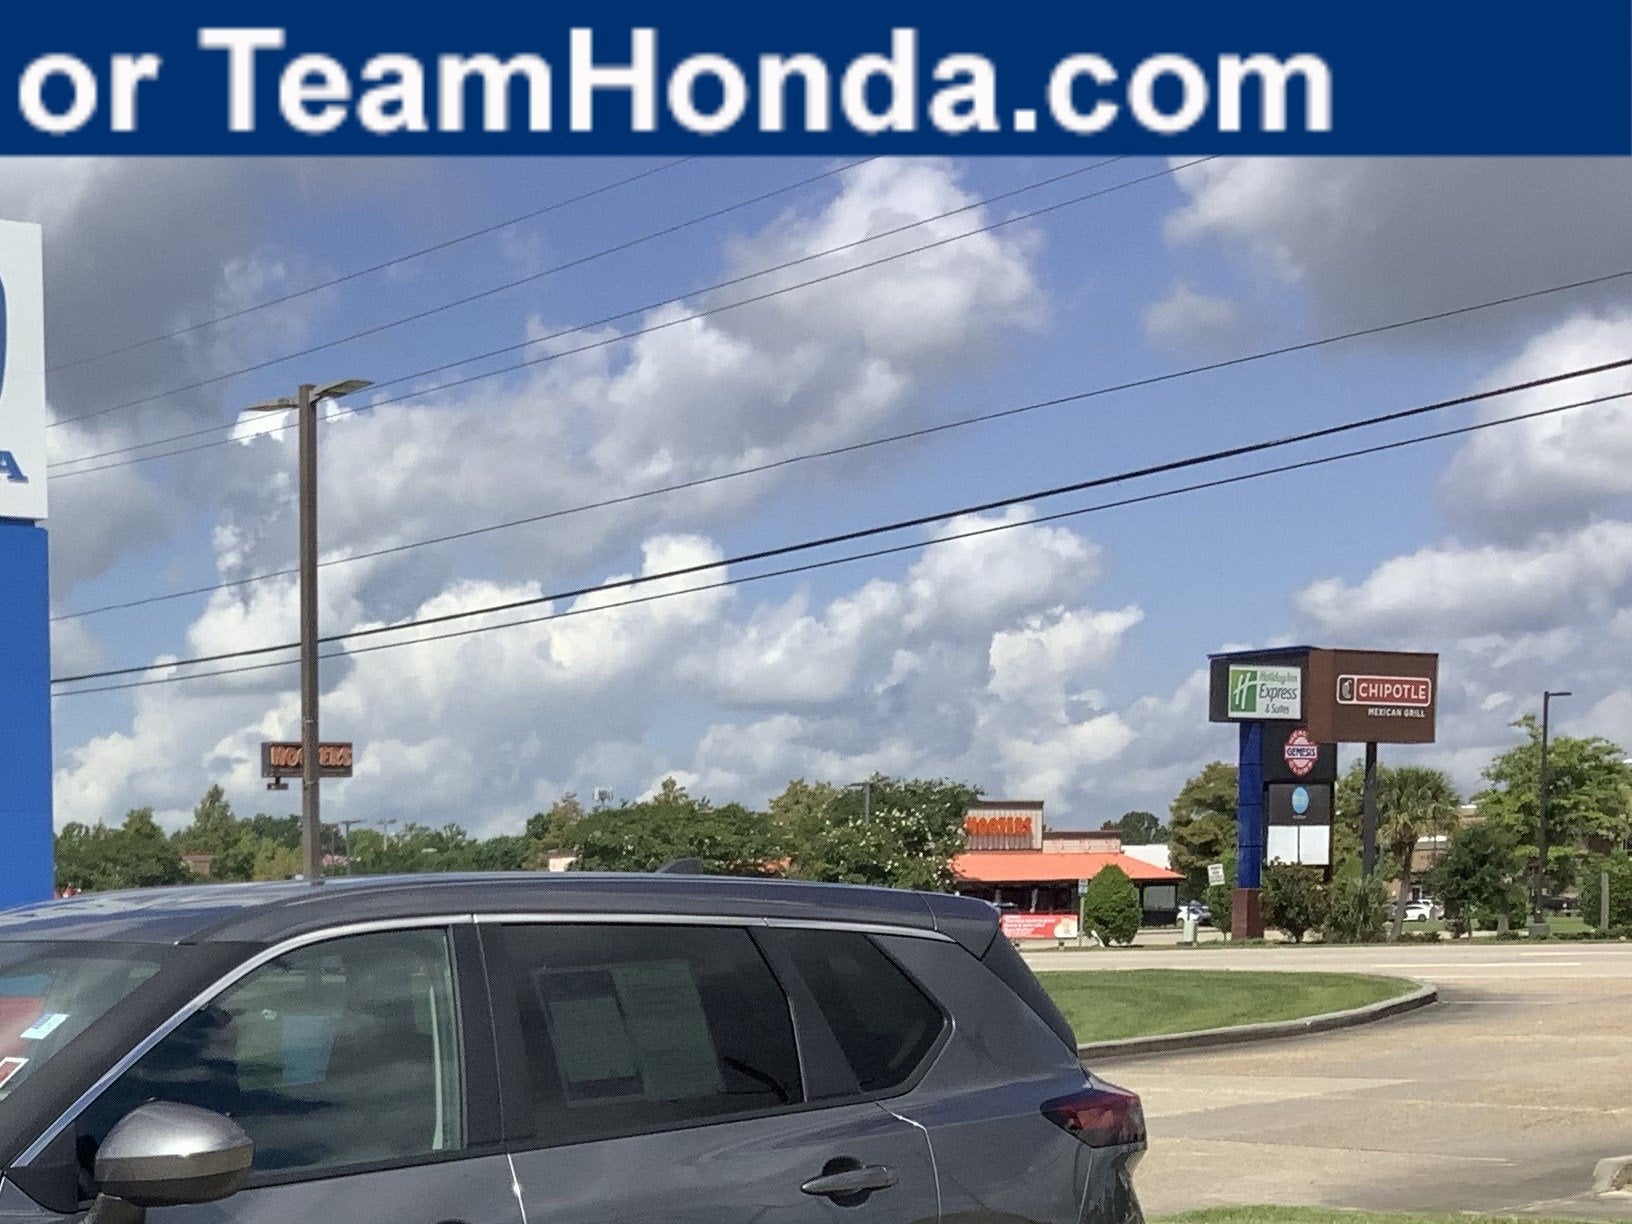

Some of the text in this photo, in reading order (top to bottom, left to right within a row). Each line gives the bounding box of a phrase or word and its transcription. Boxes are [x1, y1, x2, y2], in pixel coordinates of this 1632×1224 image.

[1259, 685, 1297, 702] Express
[1358, 683, 1427, 699] CHIPOTLE
[1272, 704, 1289, 714] Suites
[1368, 707, 1425, 718] MEXICAN GRILL
[1286, 747, 1316, 757] GENESIS
[965, 816, 1032, 835] HOOTERS
